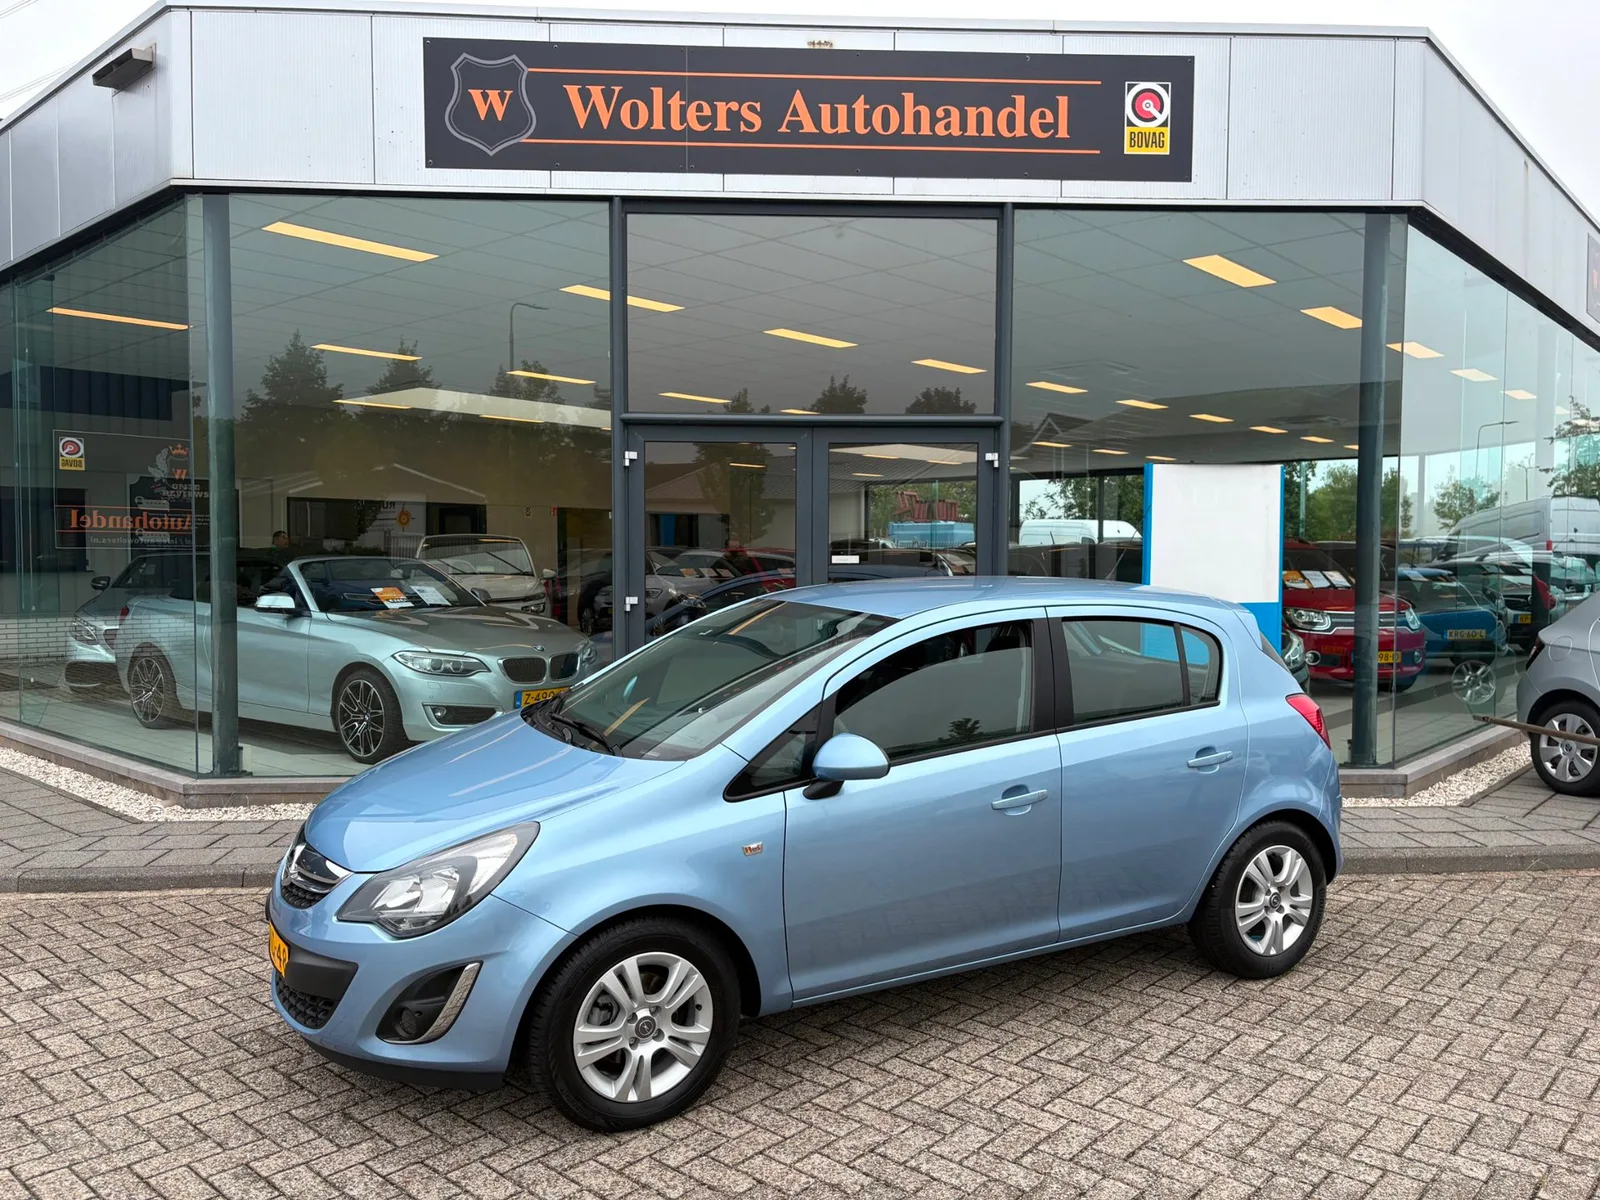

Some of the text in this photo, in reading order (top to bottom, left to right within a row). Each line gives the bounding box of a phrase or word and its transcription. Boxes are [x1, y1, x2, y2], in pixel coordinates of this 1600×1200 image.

[469, 89, 512, 121] W
[564, 84, 1069, 139] Wolters Autohandel
[1129, 131, 1165, 149] BOVAG
